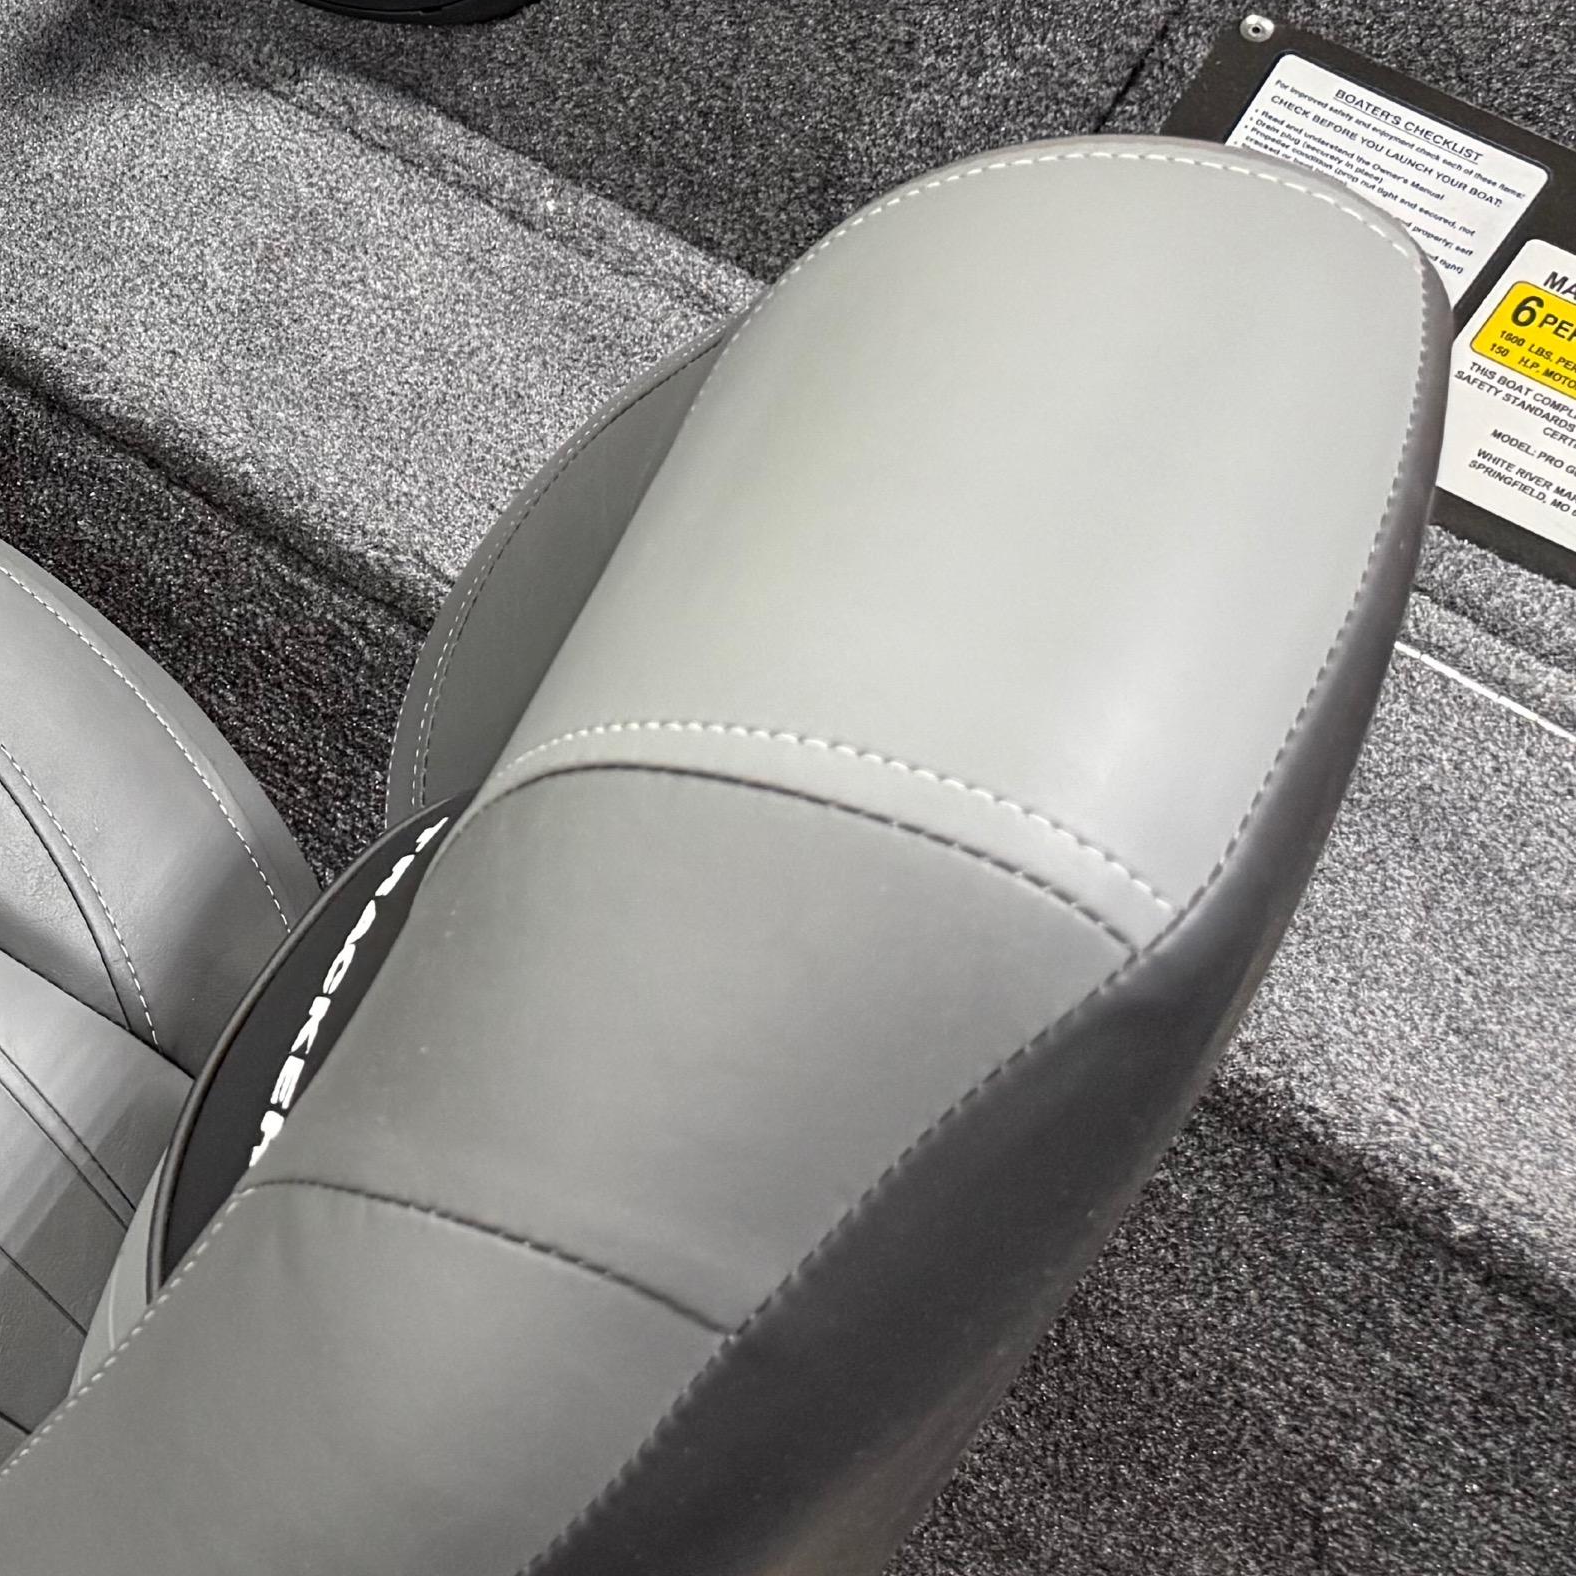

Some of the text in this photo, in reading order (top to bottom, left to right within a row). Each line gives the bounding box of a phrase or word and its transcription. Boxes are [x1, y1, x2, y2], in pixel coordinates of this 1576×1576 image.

[1269, 94, 1311, 118] CHECK
[1311, 114, 1358, 141] BEFORE
[1358, 136, 1384, 153] YOU
[1384, 147, 1433, 176] LAUNCH
[1433, 170, 1468, 192] YOUR
[1334, 88, 1483, 163] BOATER'S CHECKLIST
[1511, 295, 1544, 327] 6
[1490, 343, 1510, 357] 150
[1527, 344, 1553, 362] LBS.
[1470, 362, 1497, 380] THIS
[1497, 375, 1534, 396] BOAT
[1454, 370, 1576, 433] SAFETY STANDARDS
[1491, 429, 1564, 468] MODEL: PRO
[1468, 459, 1571, 512] SPRINGFIELD, MO
[1477, 448, 1553, 491] WHITE RIVER
